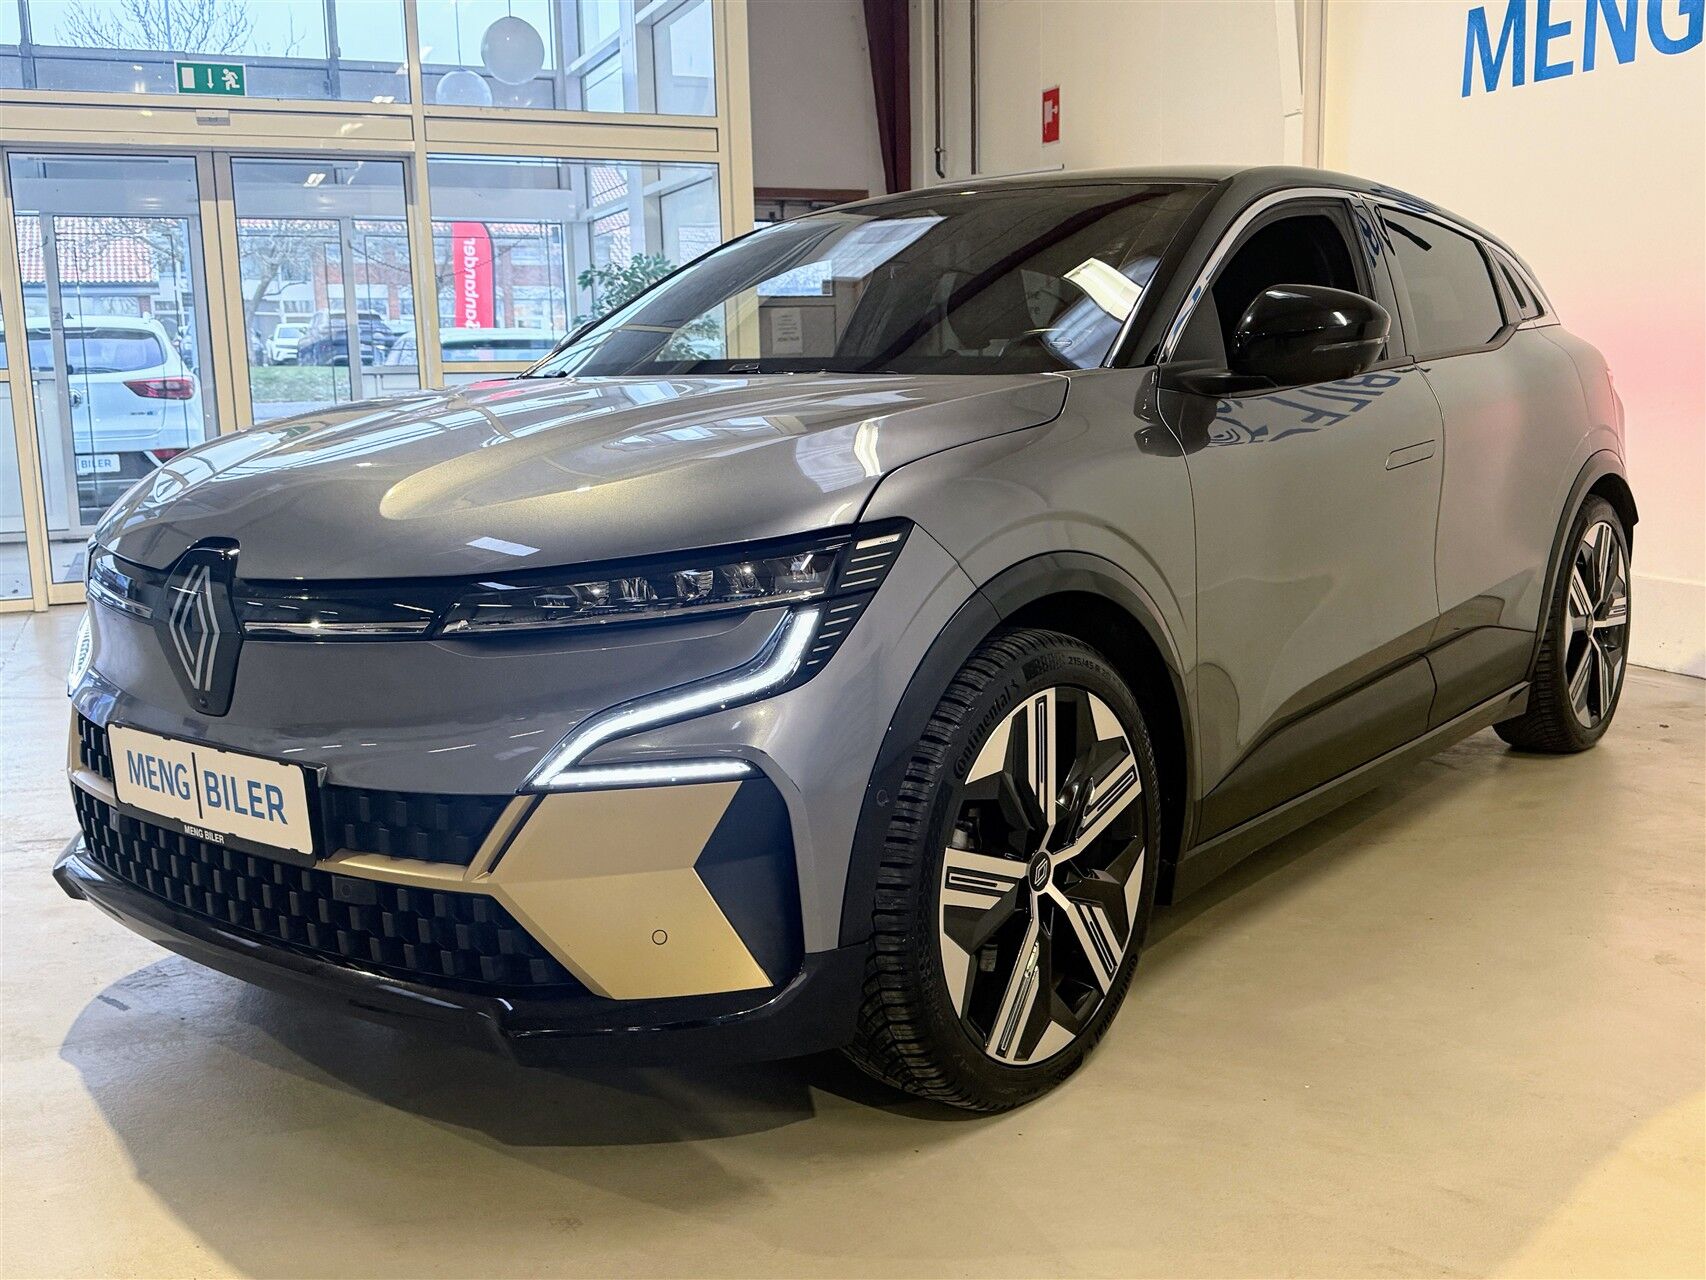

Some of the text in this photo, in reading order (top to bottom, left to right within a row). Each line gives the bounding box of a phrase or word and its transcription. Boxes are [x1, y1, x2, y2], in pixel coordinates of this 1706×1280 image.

[1462, 0, 1705, 98] MENG
[953, 686, 1012, 780] Continental
[127, 750, 289, 825] MENG BILER
[184, 824, 225, 844] MENG BILER
